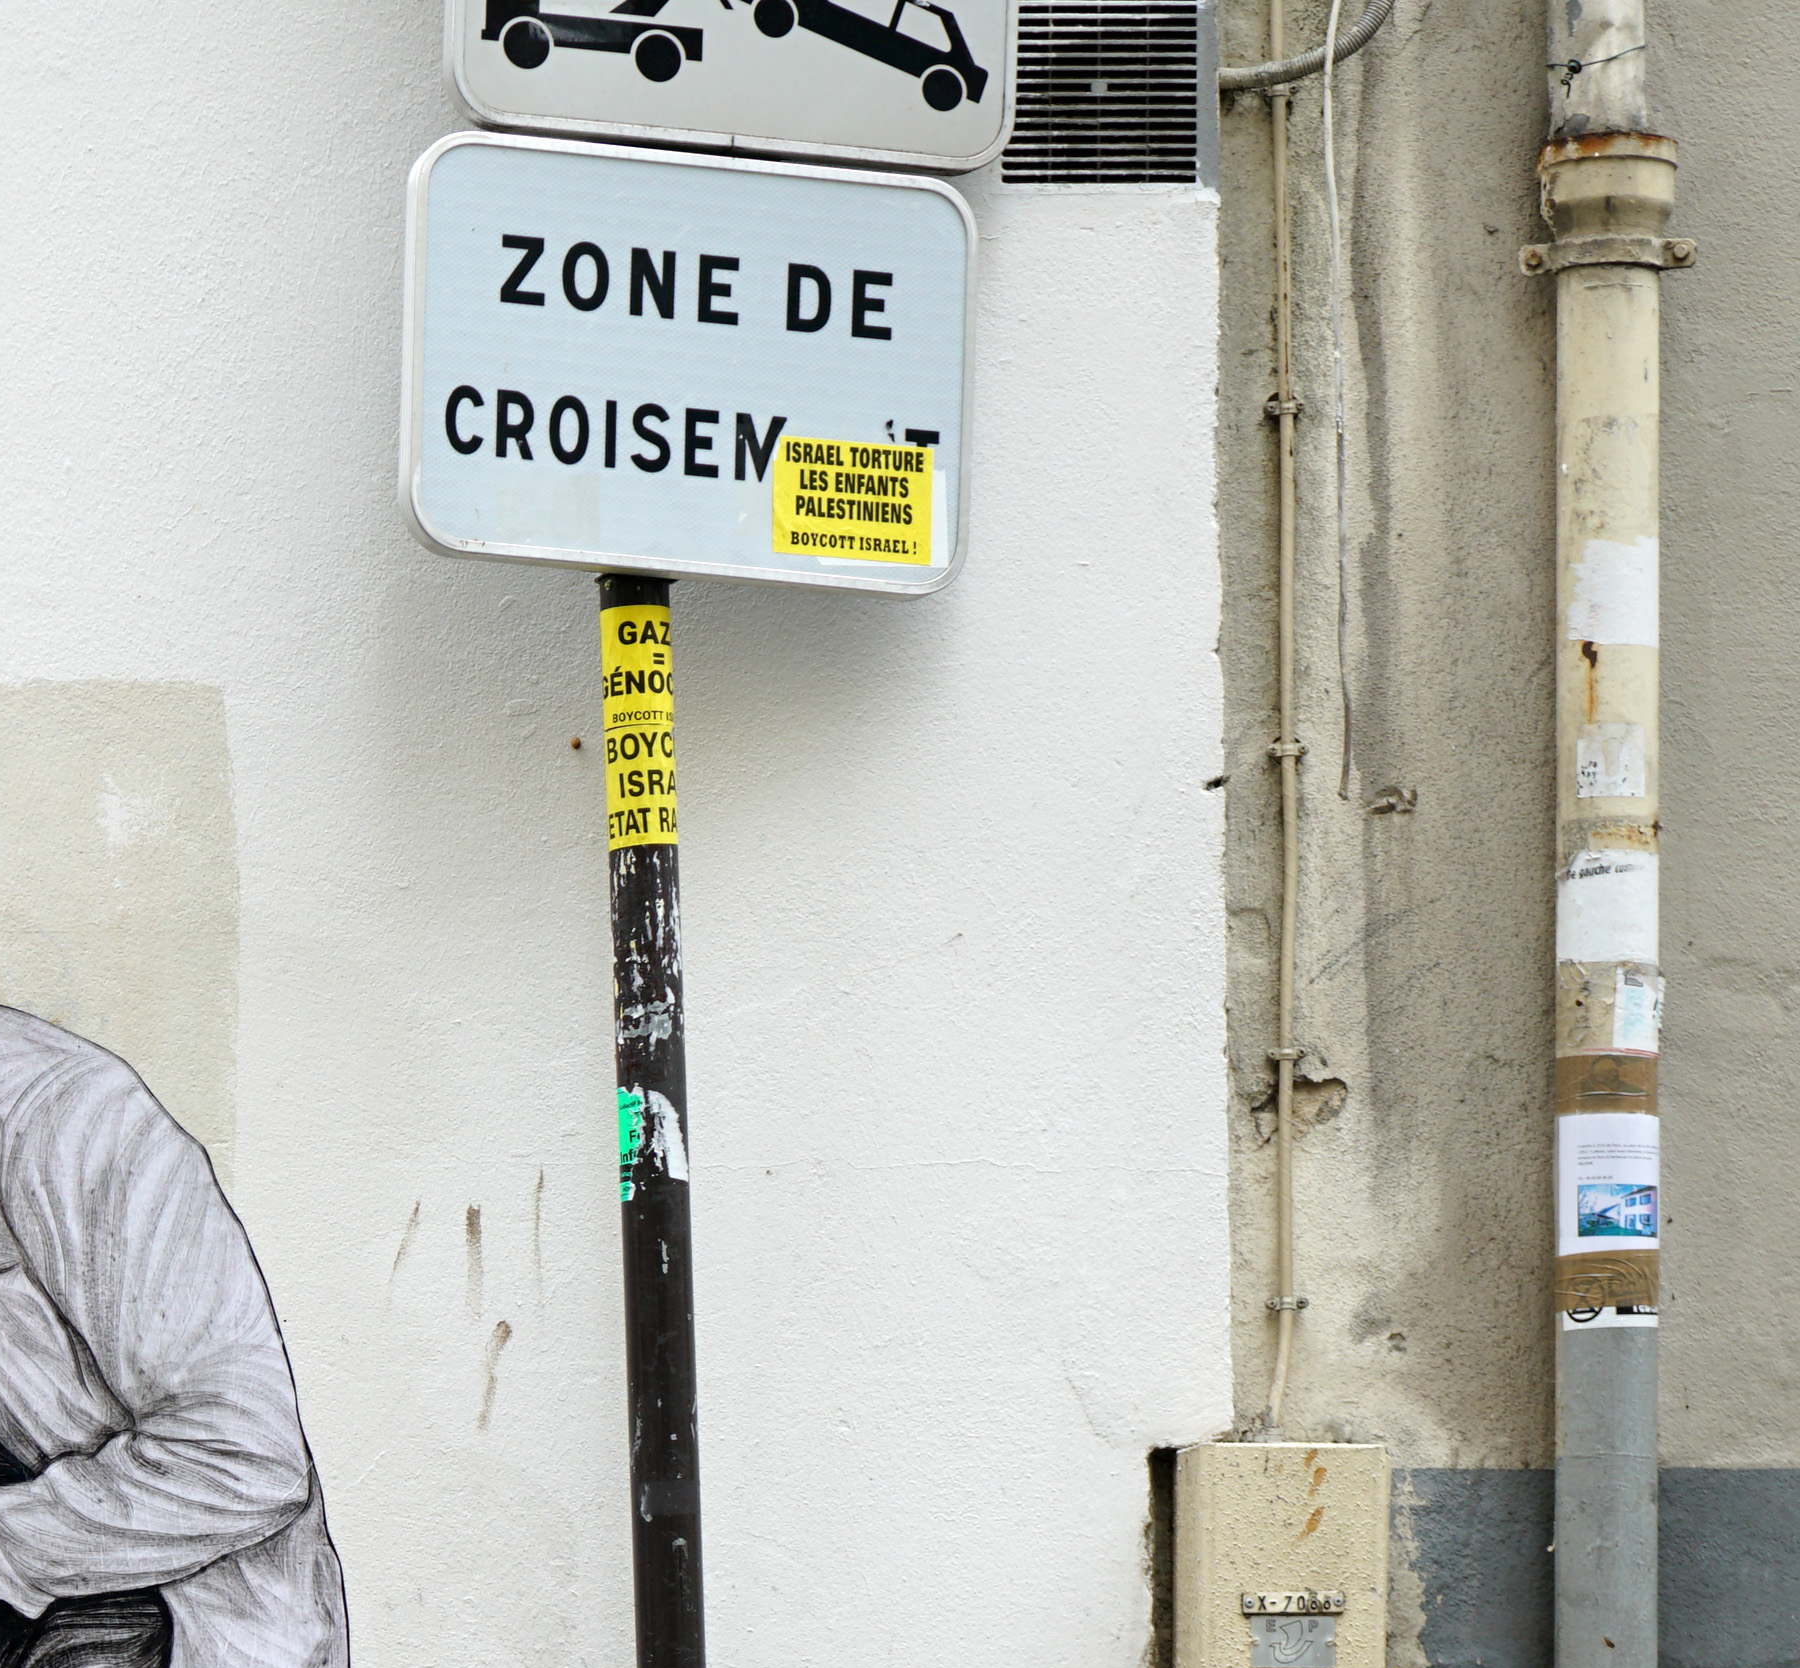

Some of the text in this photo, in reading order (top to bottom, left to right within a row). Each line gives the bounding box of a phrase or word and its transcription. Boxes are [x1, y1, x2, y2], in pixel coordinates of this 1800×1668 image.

[499, 233, 893, 340] ZONE DE
[444, 384, 941, 482] CROISEM
[785, 441, 924, 473] ISRAEL TORTURE
[799, 468, 909, 499] LES ENFANTS
[795, 495, 913, 525] PALESTINIENS
[790, 531, 856, 549] BOYCOTT
[859, 537, 909, 554] ISRAEL
[612, 710, 664, 723] BOYCOTT
[606, 731, 673, 764] BOYC
[619, 769, 677, 798] ISRA
[608, 807, 651, 840] ETAT
